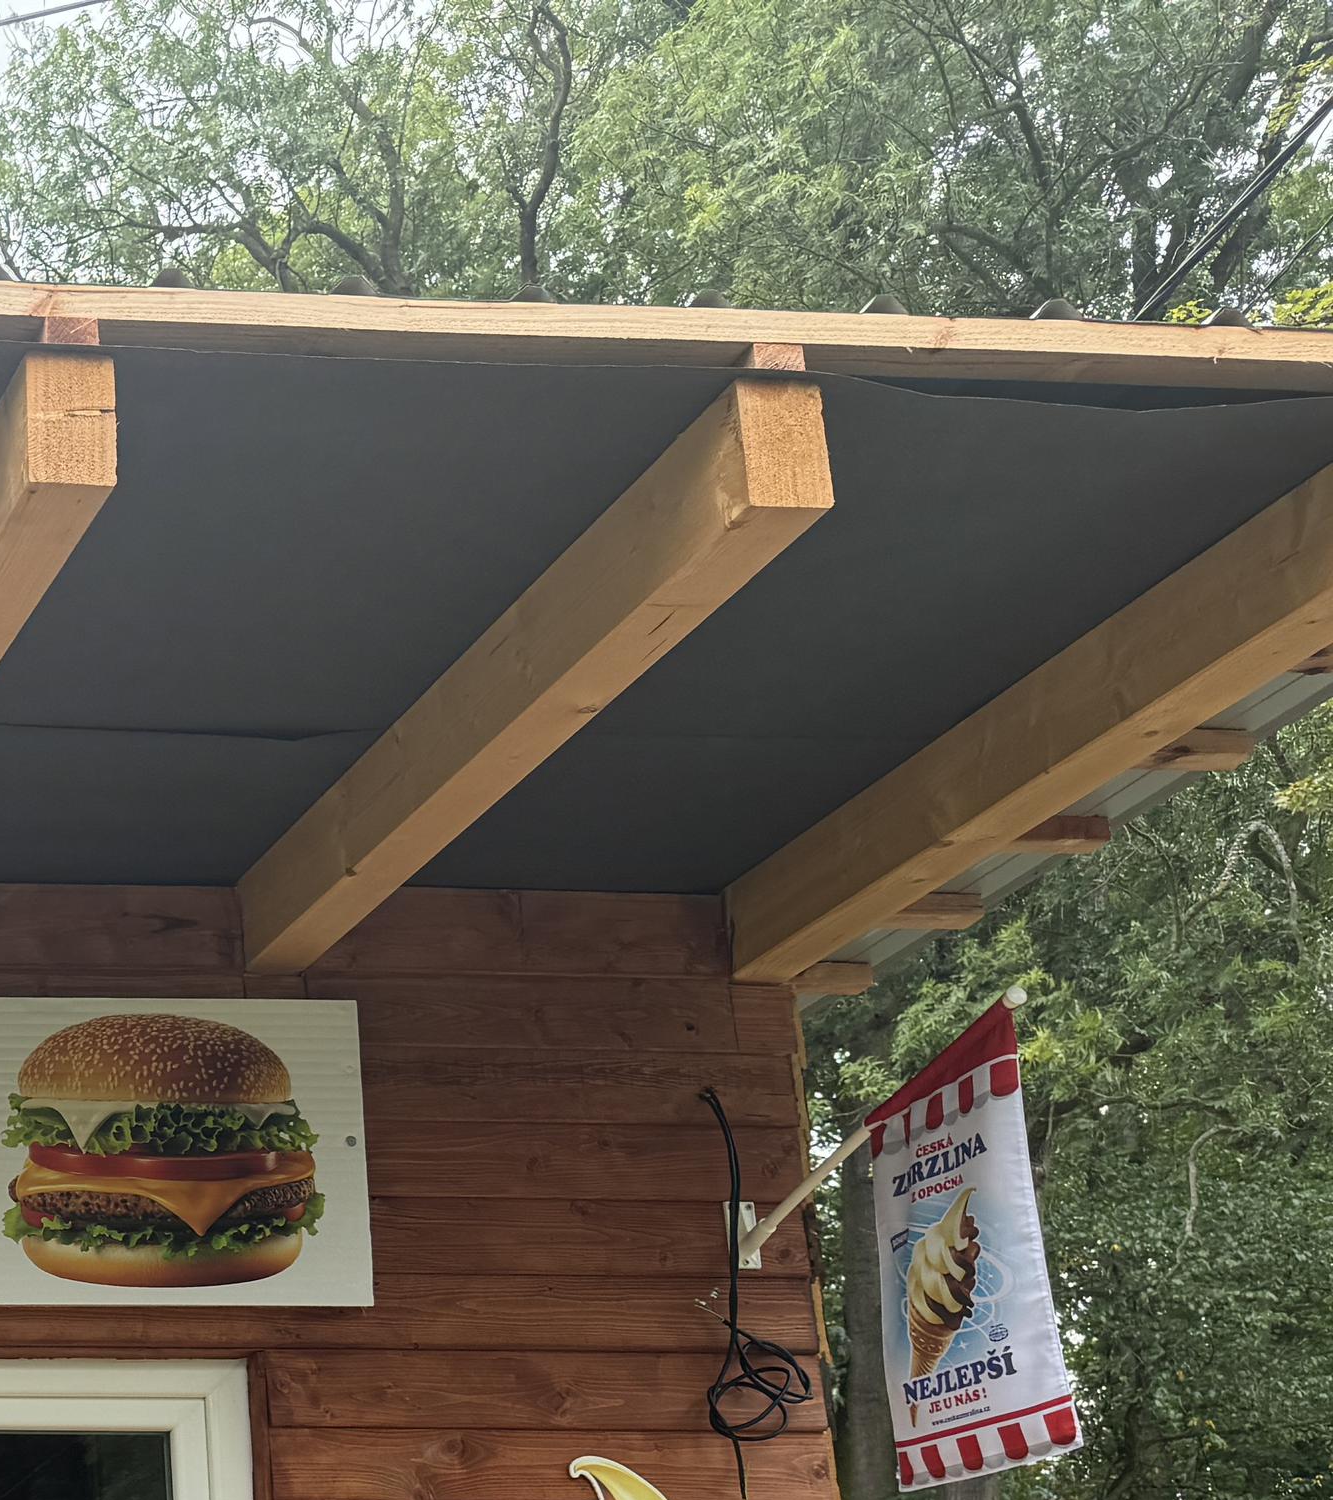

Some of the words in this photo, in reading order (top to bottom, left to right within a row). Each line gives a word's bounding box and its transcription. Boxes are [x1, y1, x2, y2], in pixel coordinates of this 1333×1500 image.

[916, 1132, 954, 1158] ČESKÁ
[918, 1174, 965, 1200] OPOČNA
[903, 1345, 1017, 1405] NEJLEPŠÍ
[929, 1400, 942, 1414] JE
[944, 1397, 952, 1409] U
